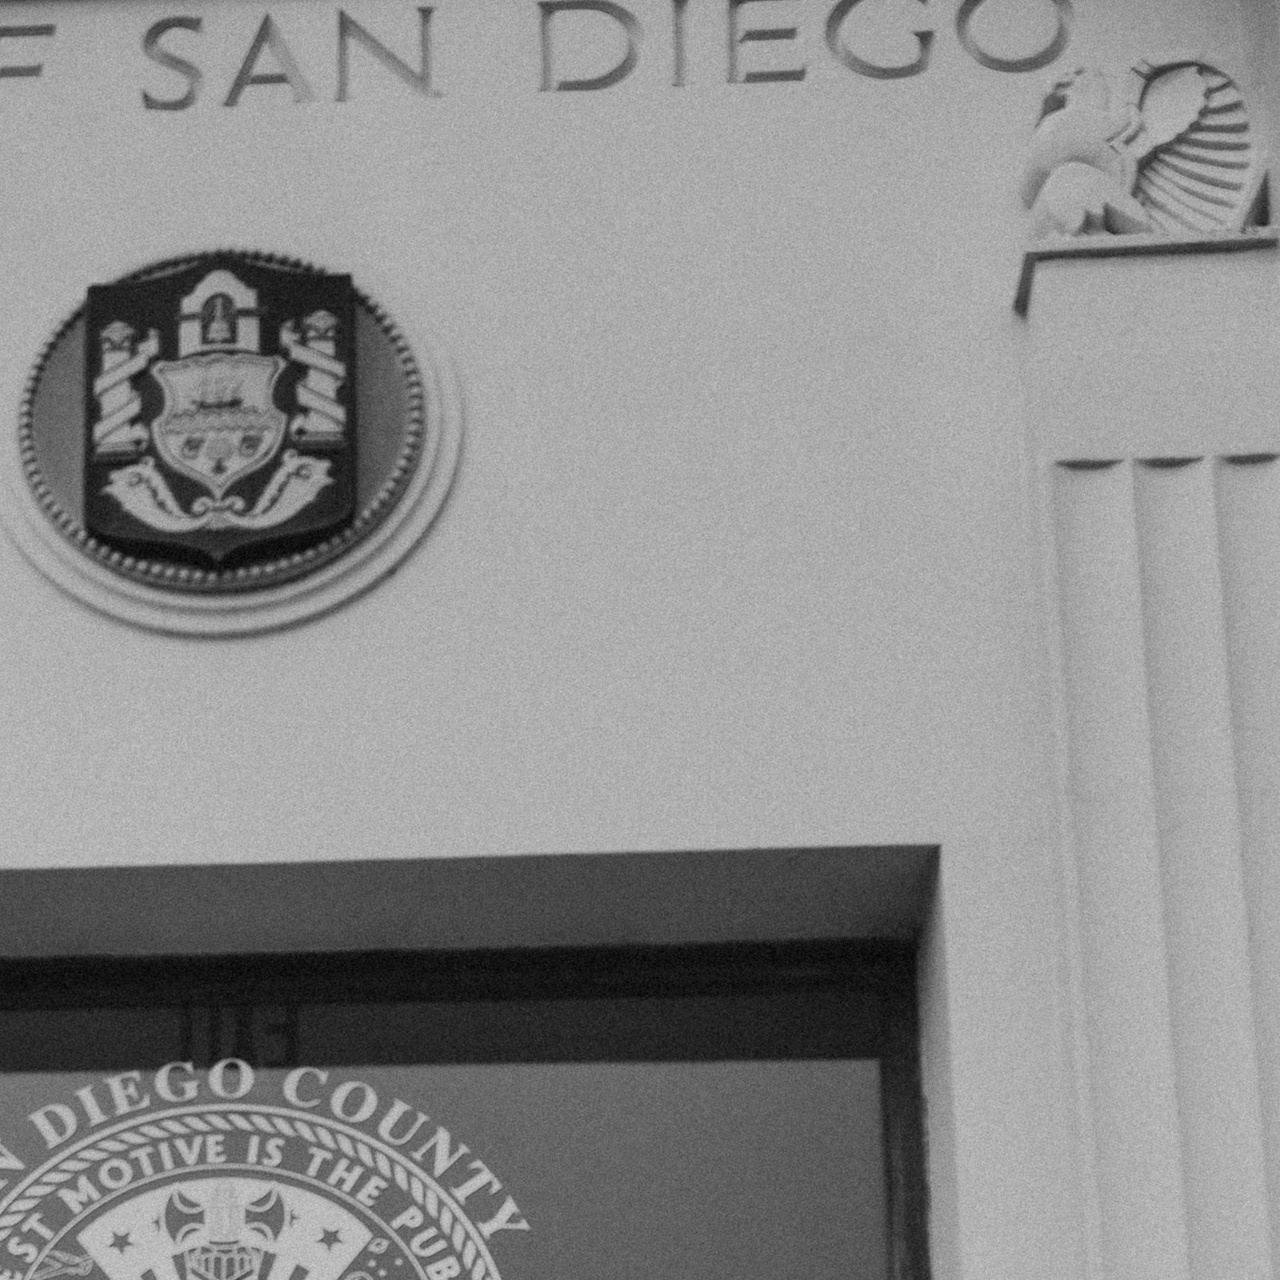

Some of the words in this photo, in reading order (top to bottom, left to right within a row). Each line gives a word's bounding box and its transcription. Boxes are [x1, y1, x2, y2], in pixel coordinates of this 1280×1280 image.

[141, 5, 443, 112] SAN
[537, 0, 1075, 93] DIEGO
[27, 1057, 255, 1150] DIEGO
[282, 1066, 531, 1240] COUNTY
[57, 1134, 227, 1214] MOTIVE
[247, 1134, 286, 1167] IS
[306, 1146, 389, 1206] THE
